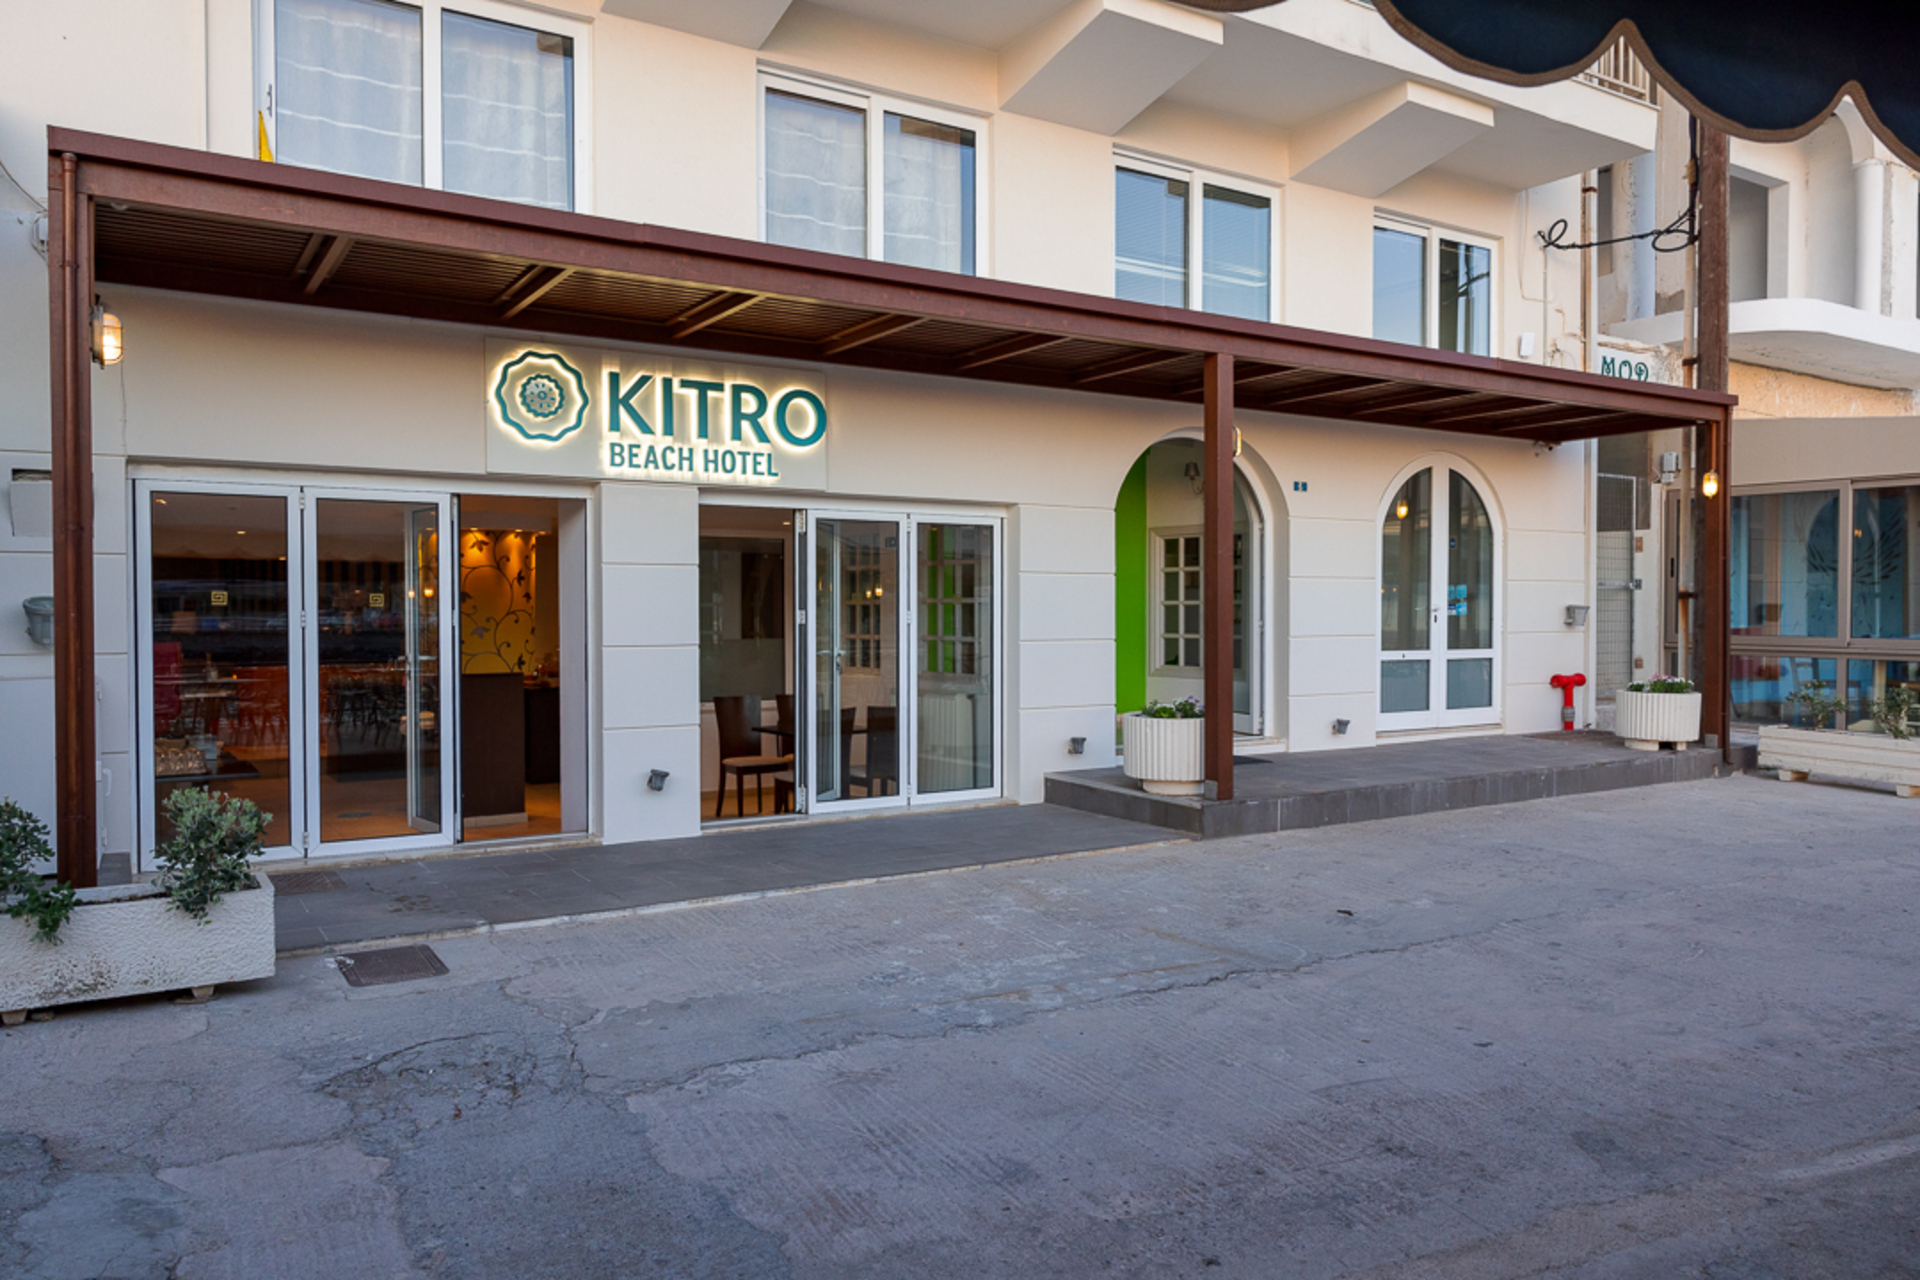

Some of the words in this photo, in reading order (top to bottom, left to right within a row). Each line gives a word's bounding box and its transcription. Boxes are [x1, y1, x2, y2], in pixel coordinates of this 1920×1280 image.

[609, 371, 827, 446] KITRO
[610, 442, 694, 471] BEACH
[703, 449, 779, 477] HOTEL
